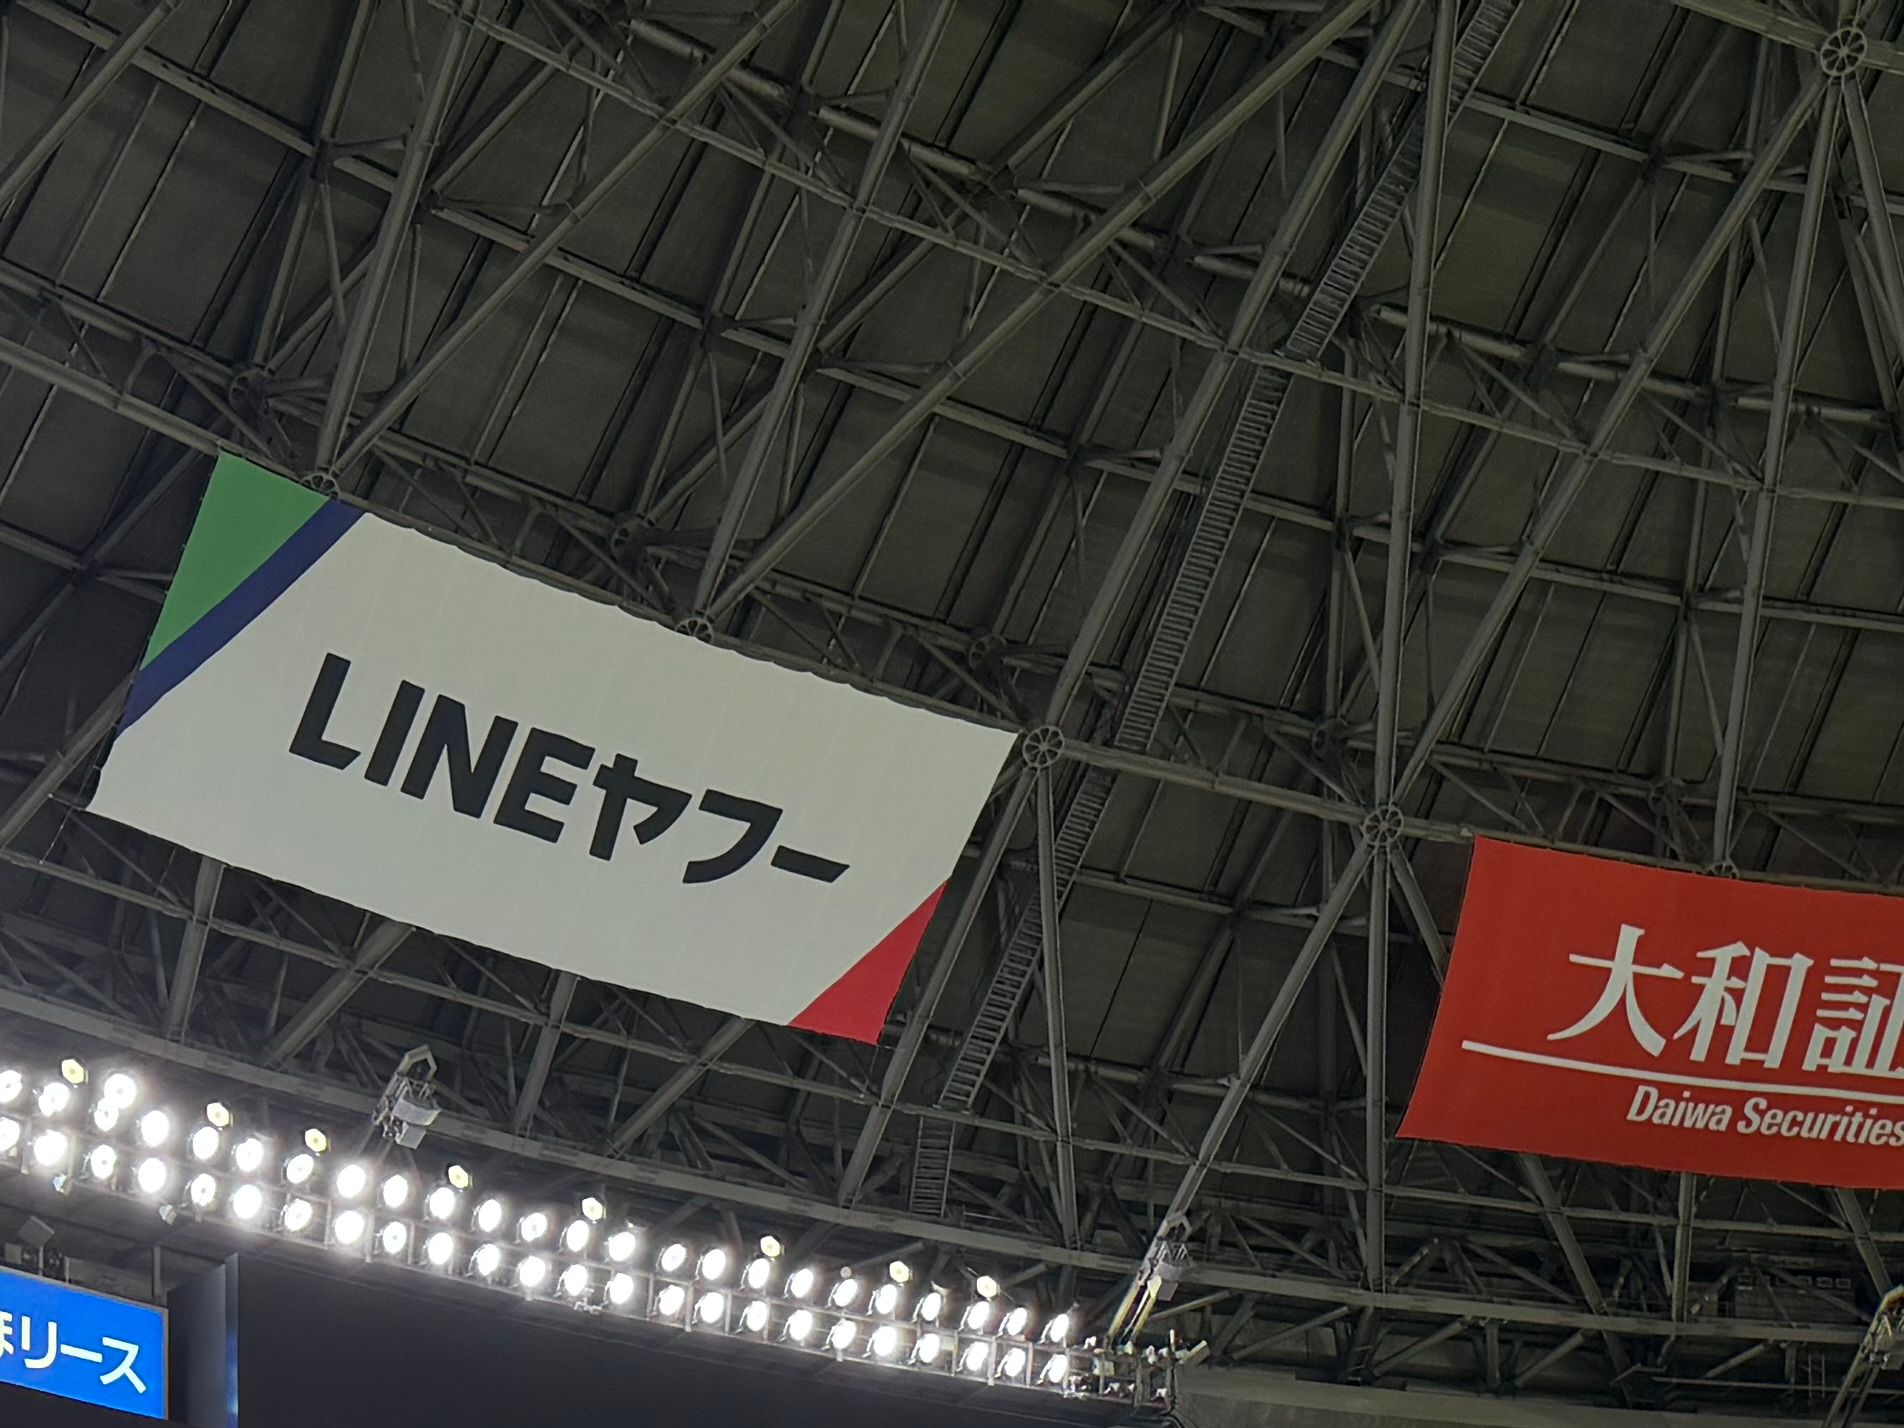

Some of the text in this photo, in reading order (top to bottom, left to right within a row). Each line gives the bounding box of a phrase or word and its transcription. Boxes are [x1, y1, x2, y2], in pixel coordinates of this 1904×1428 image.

[289, 652, 851, 884] LINEヤフー
[1626, 1085, 1729, 1133] Daiwa
